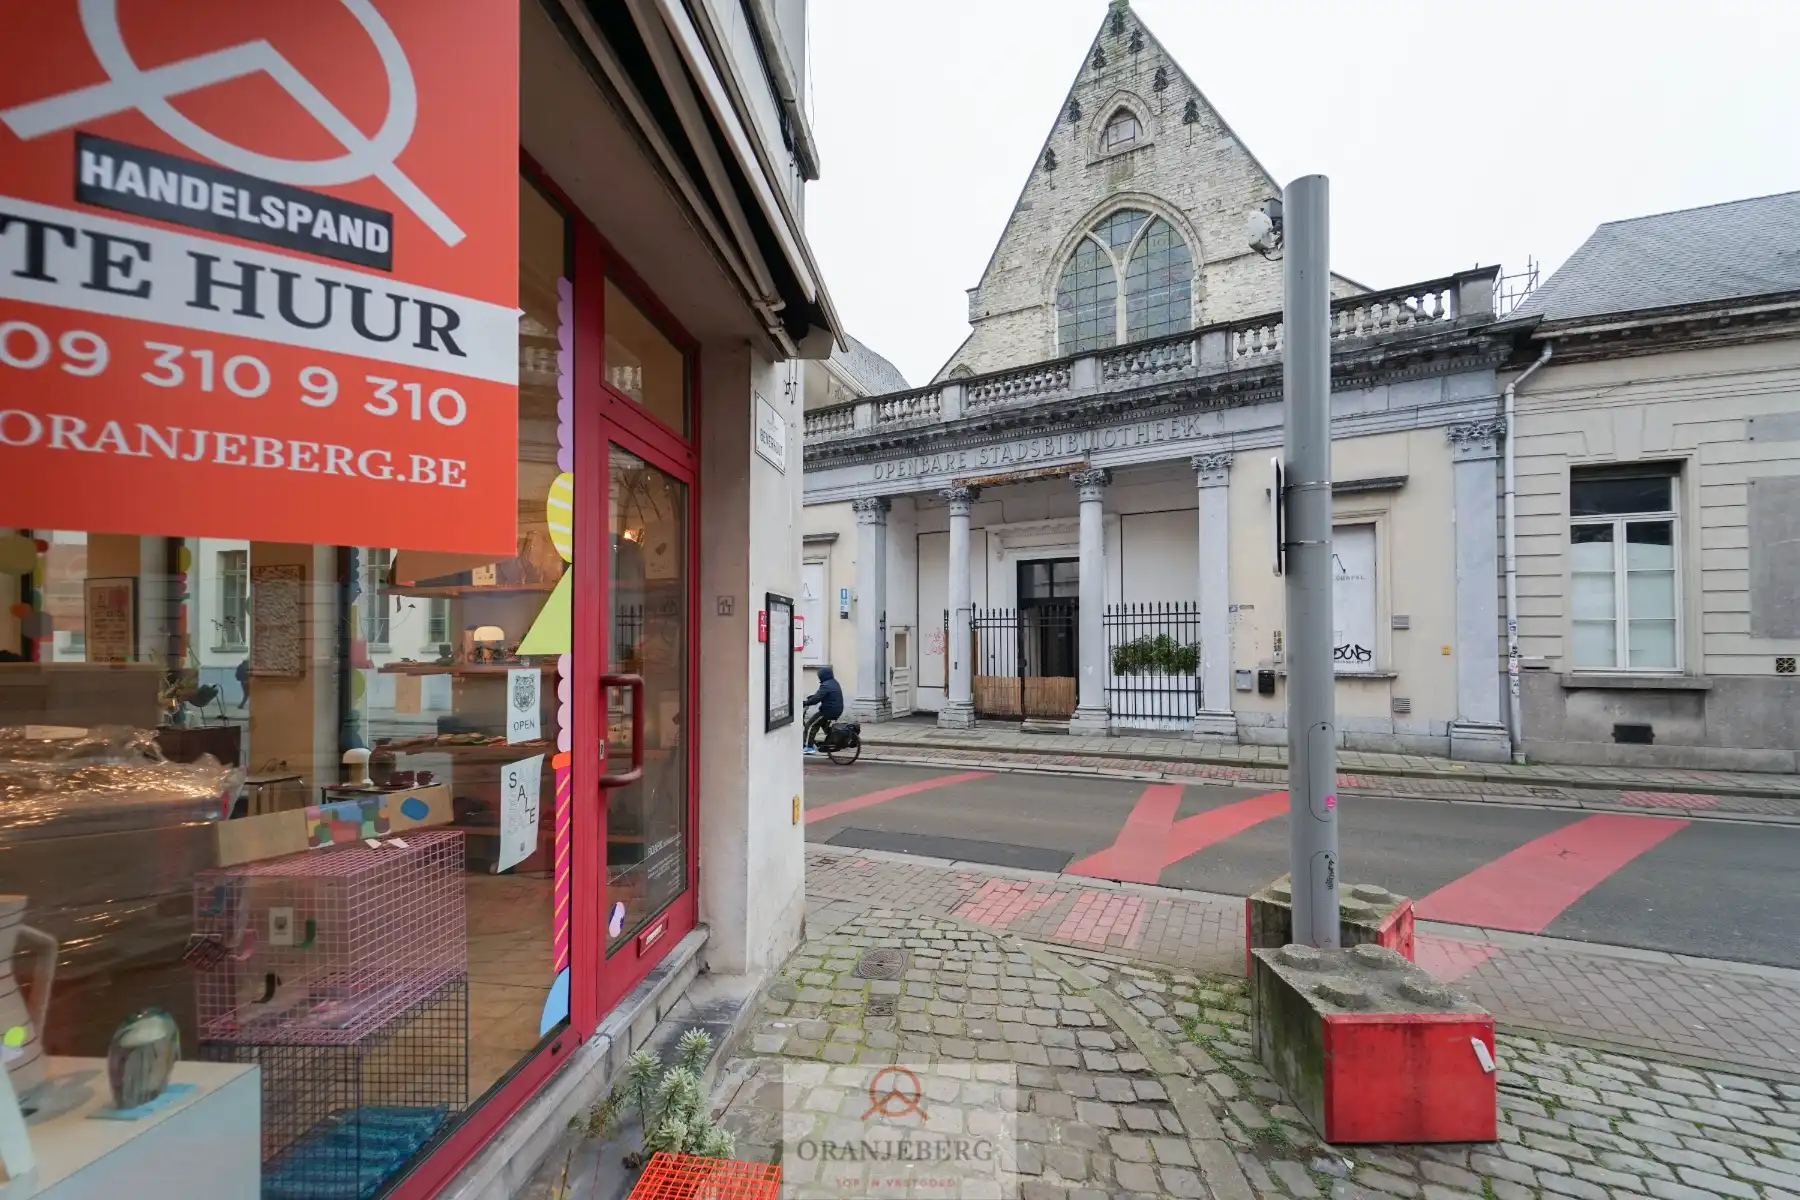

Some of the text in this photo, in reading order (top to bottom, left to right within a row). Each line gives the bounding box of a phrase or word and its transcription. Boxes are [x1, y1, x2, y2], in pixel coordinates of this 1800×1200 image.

[81, 151, 389, 254] HANDELSPAND
[0, 212, 467, 358] TE HUUR
[0, 320, 467, 427] 09 310 9 310
[0, 409, 467, 488] ORANJEBERG.BE
[873, 452, 967, 480] OPENBARE
[513, 718, 535, 731] OPEN
[508, 772, 536, 825] SALE
